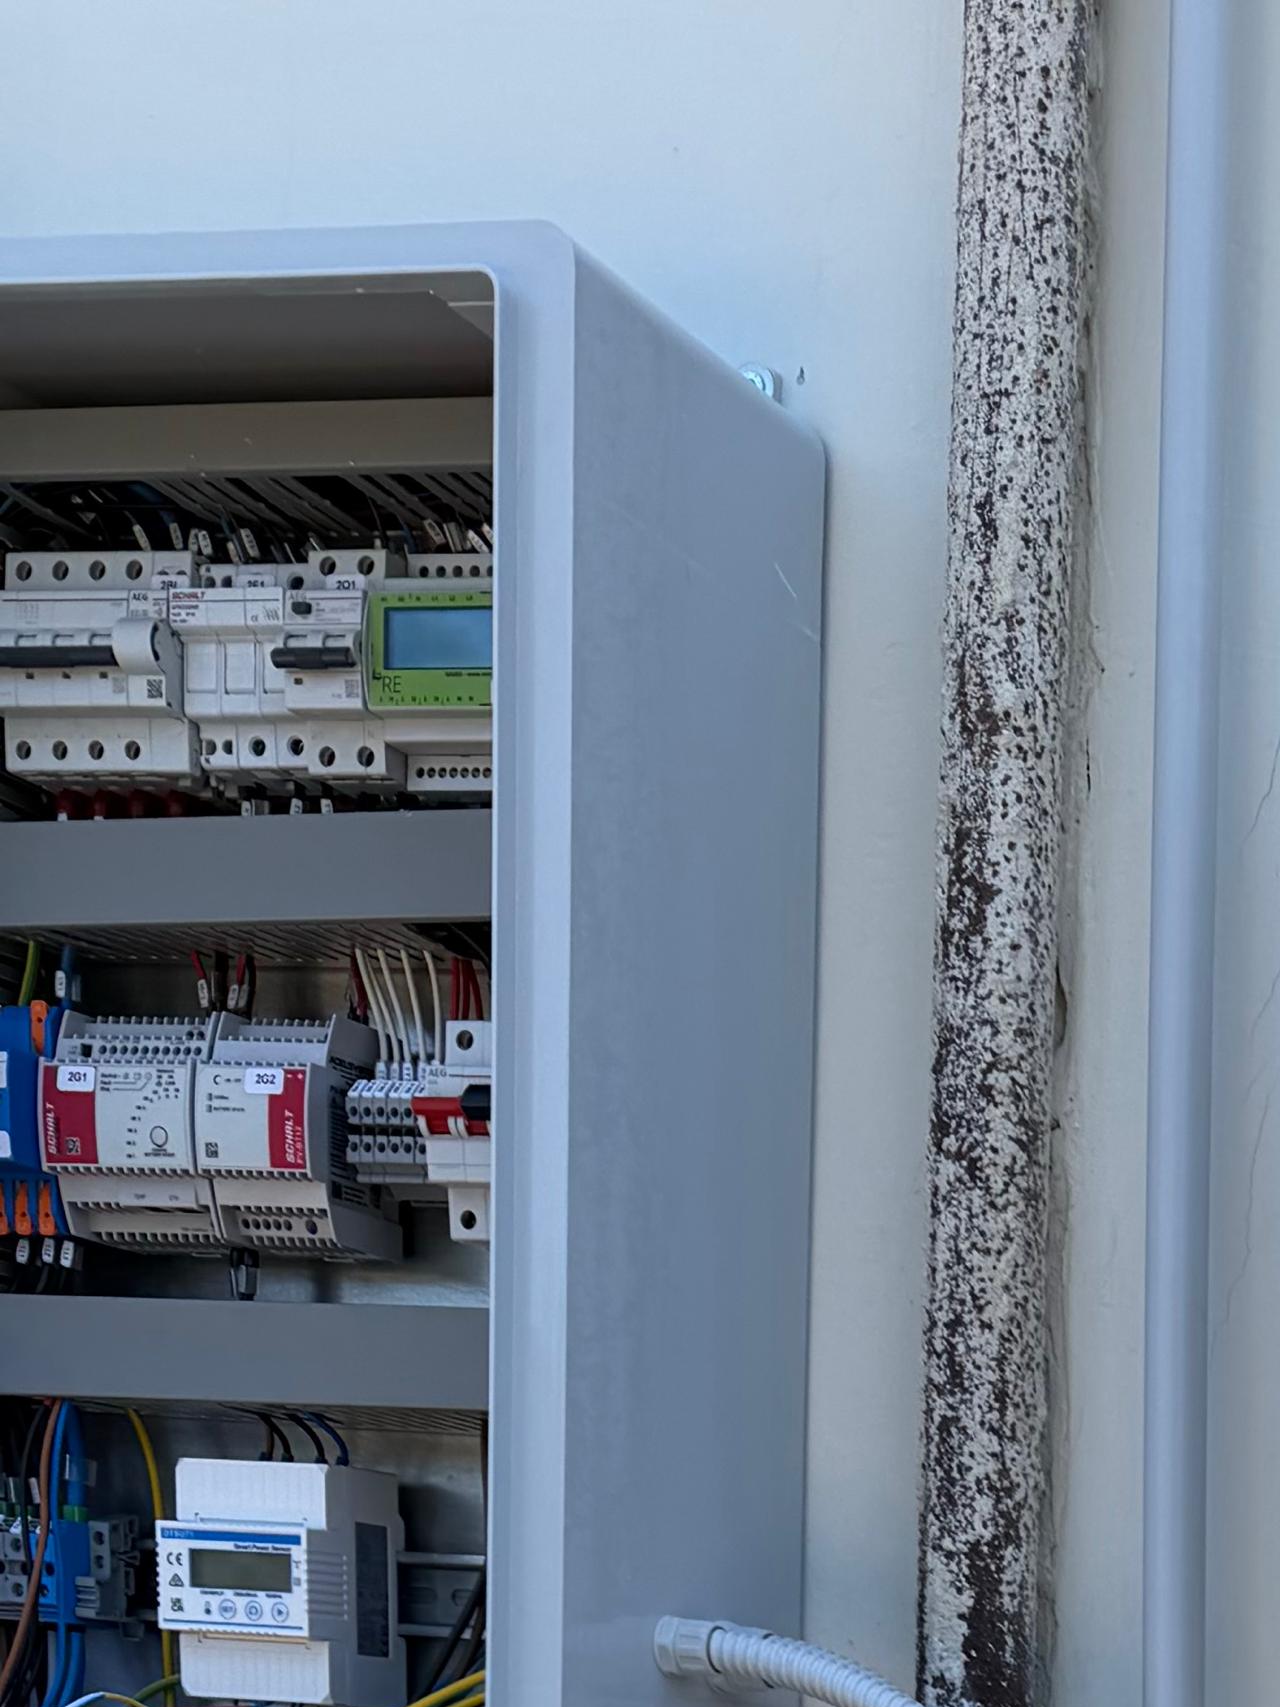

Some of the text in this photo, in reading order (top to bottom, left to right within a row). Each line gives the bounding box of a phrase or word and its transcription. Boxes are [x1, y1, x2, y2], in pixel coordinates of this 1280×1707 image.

[67, 1071, 87, 1082] 2G1
[255, 1073, 276, 1085] 2G2
[45, 1102, 56, 1155] SCHALT
[284, 1109, 295, 1164] SCHALT
